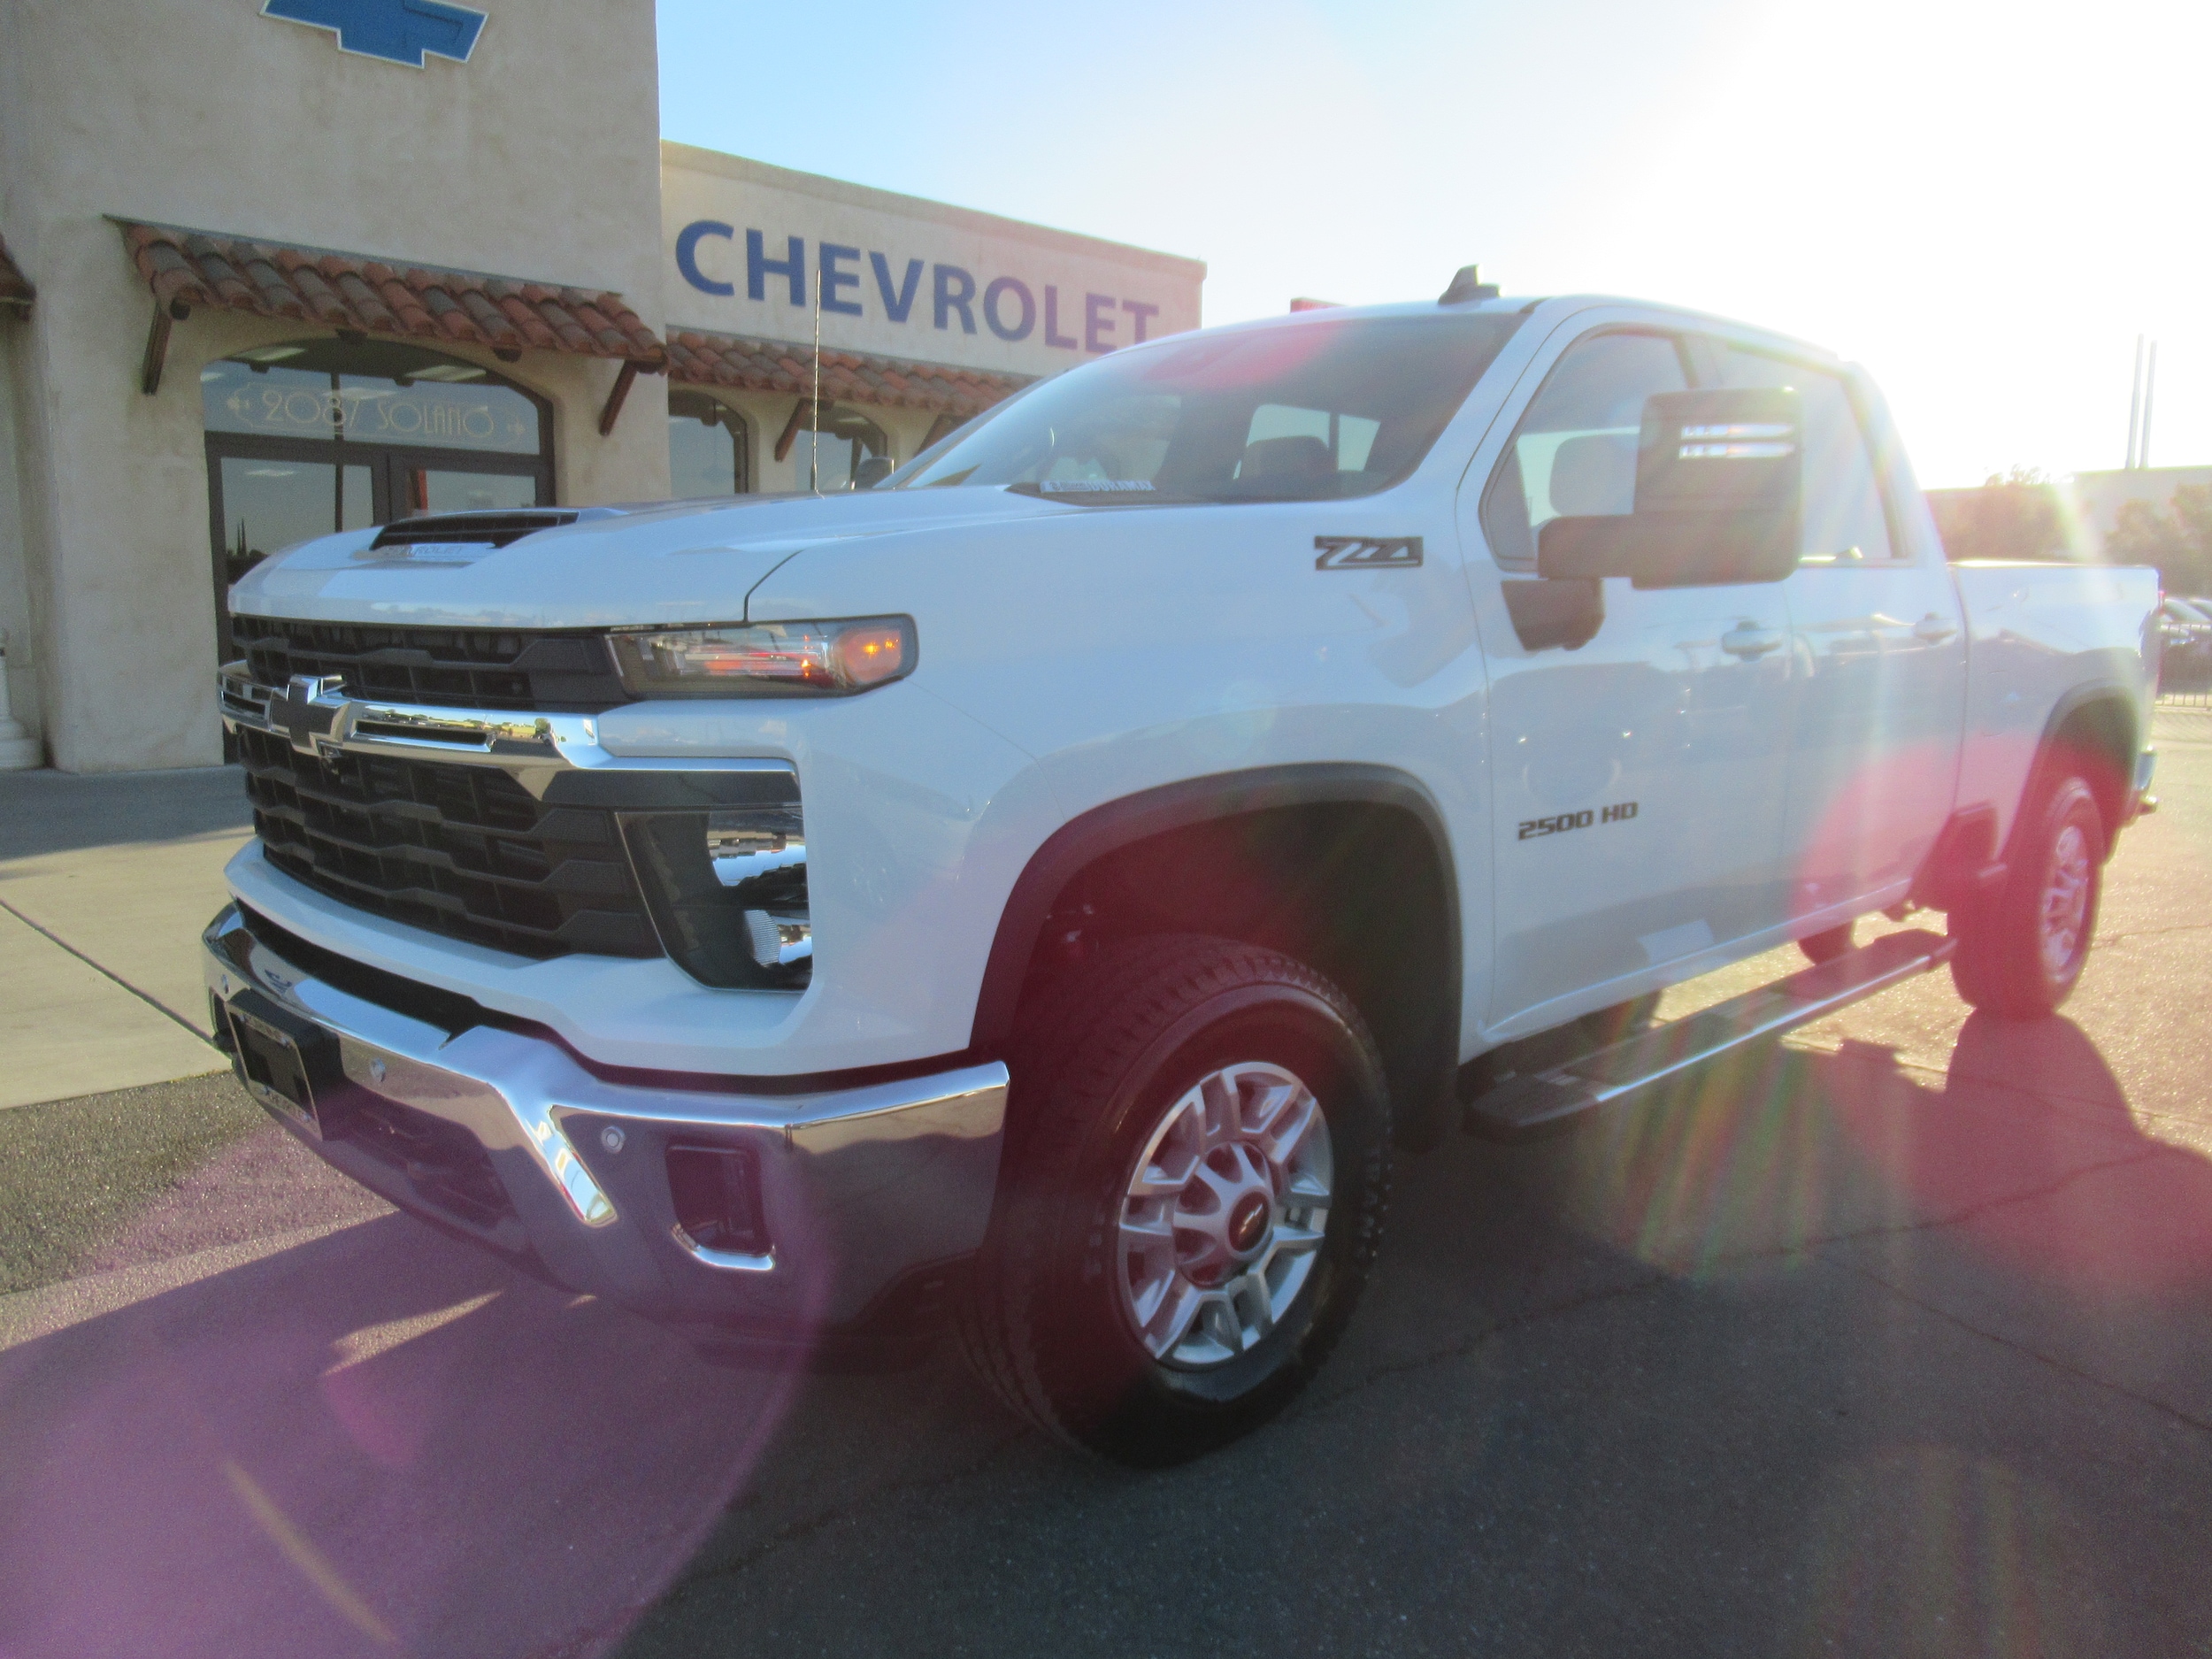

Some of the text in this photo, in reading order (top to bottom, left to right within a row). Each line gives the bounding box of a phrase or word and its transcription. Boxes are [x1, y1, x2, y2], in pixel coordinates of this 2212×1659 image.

[675, 219, 1160, 354] CHEVROLET
[263, 390, 361, 426] 2087
[1518, 801, 1639, 841] 2500 HD
